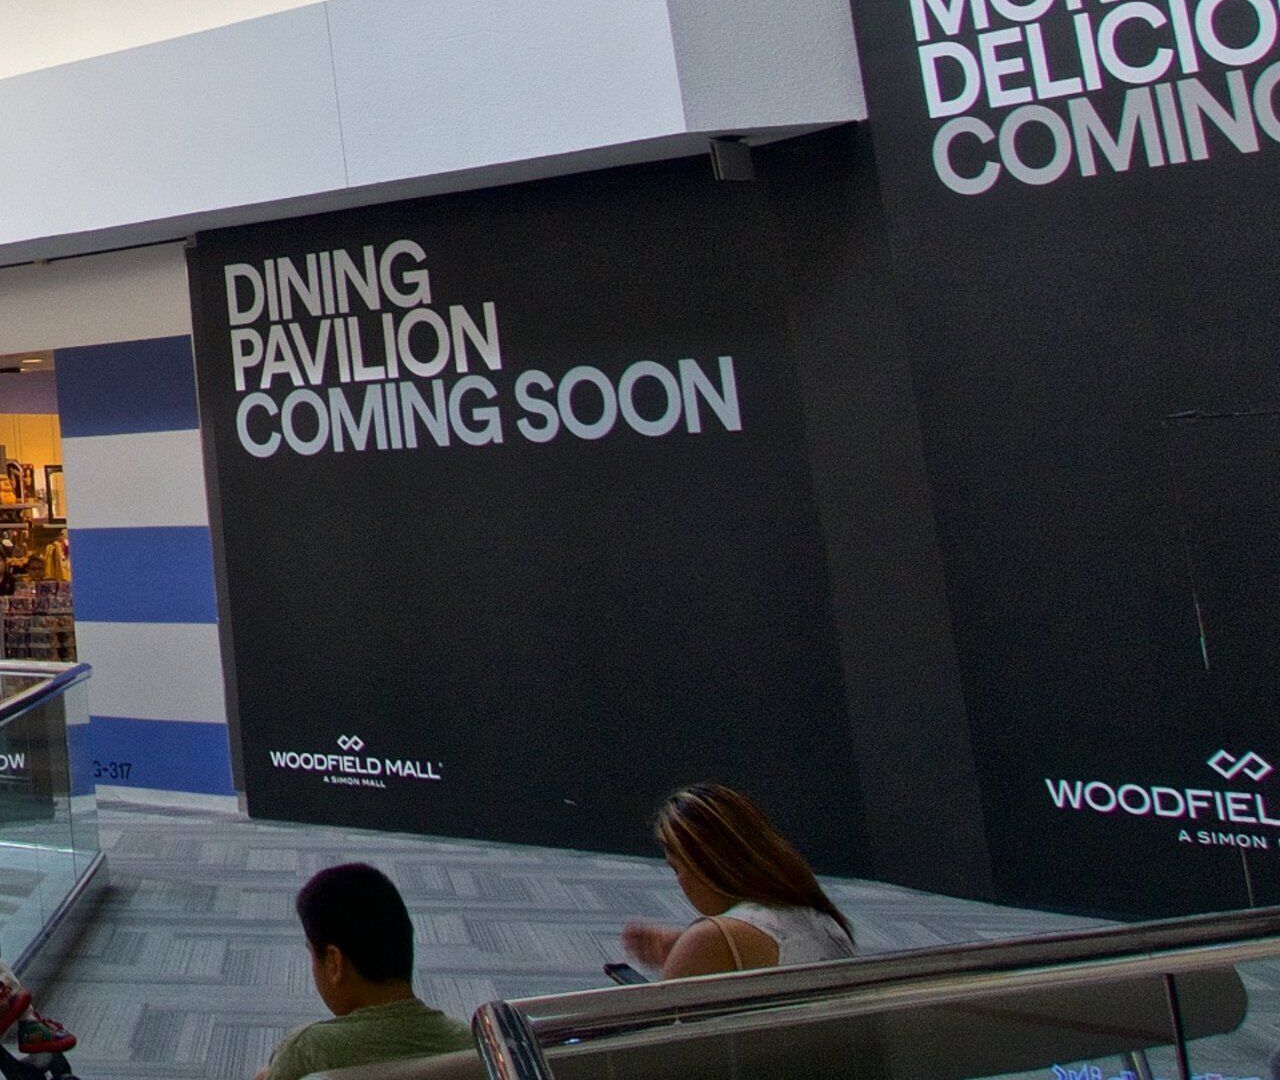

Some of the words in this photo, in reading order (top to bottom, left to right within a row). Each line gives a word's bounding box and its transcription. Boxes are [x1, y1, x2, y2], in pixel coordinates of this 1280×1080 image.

[224, 239, 432, 326] DINING
[230, 302, 502, 391] PAVILION
[236, 376, 504, 458] COMING
[514, 356, 743, 443] SOON
[269, 751, 382, 775] WOODFIELD
[323, 775, 330, 783] A
[331, 776, 360, 786] SIMON
[362, 779, 387, 788] MALL
[1178, 829, 1192, 843] A
[1197, 831, 1269, 850] SIMON
